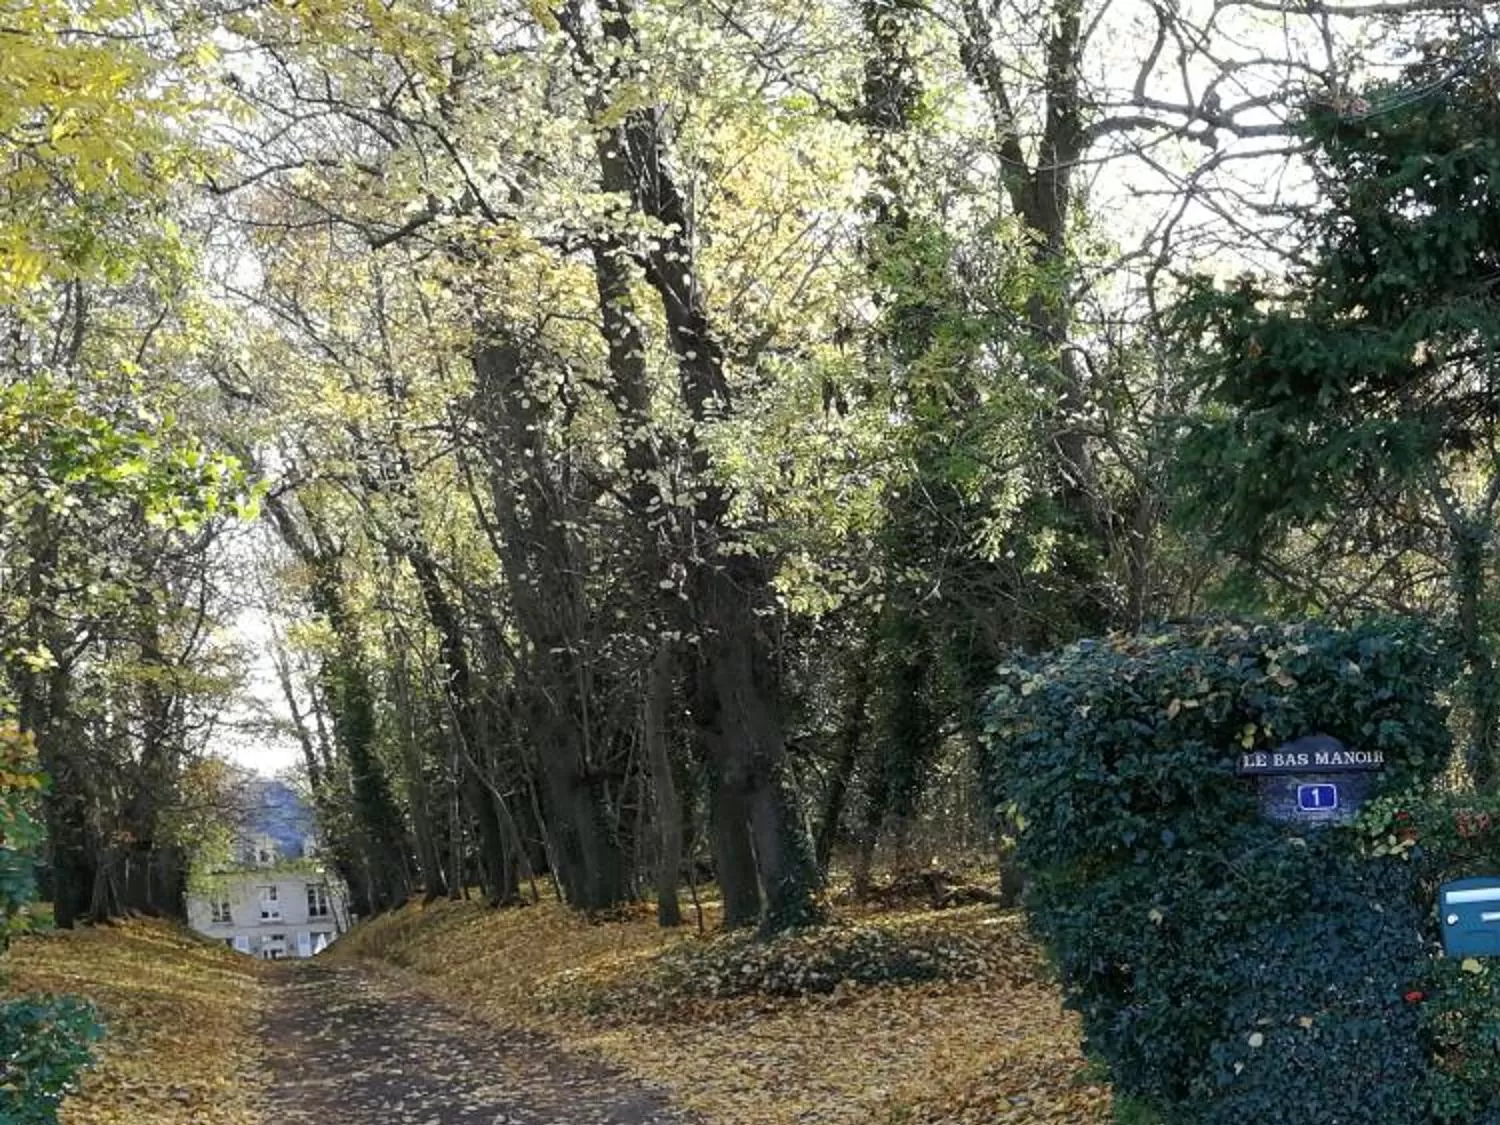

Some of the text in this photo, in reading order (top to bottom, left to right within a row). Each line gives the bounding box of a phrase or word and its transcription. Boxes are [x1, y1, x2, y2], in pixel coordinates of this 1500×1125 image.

[1243, 751, 1384, 768] LE BAS MANOIR
[1311, 788, 1320, 806] 1
